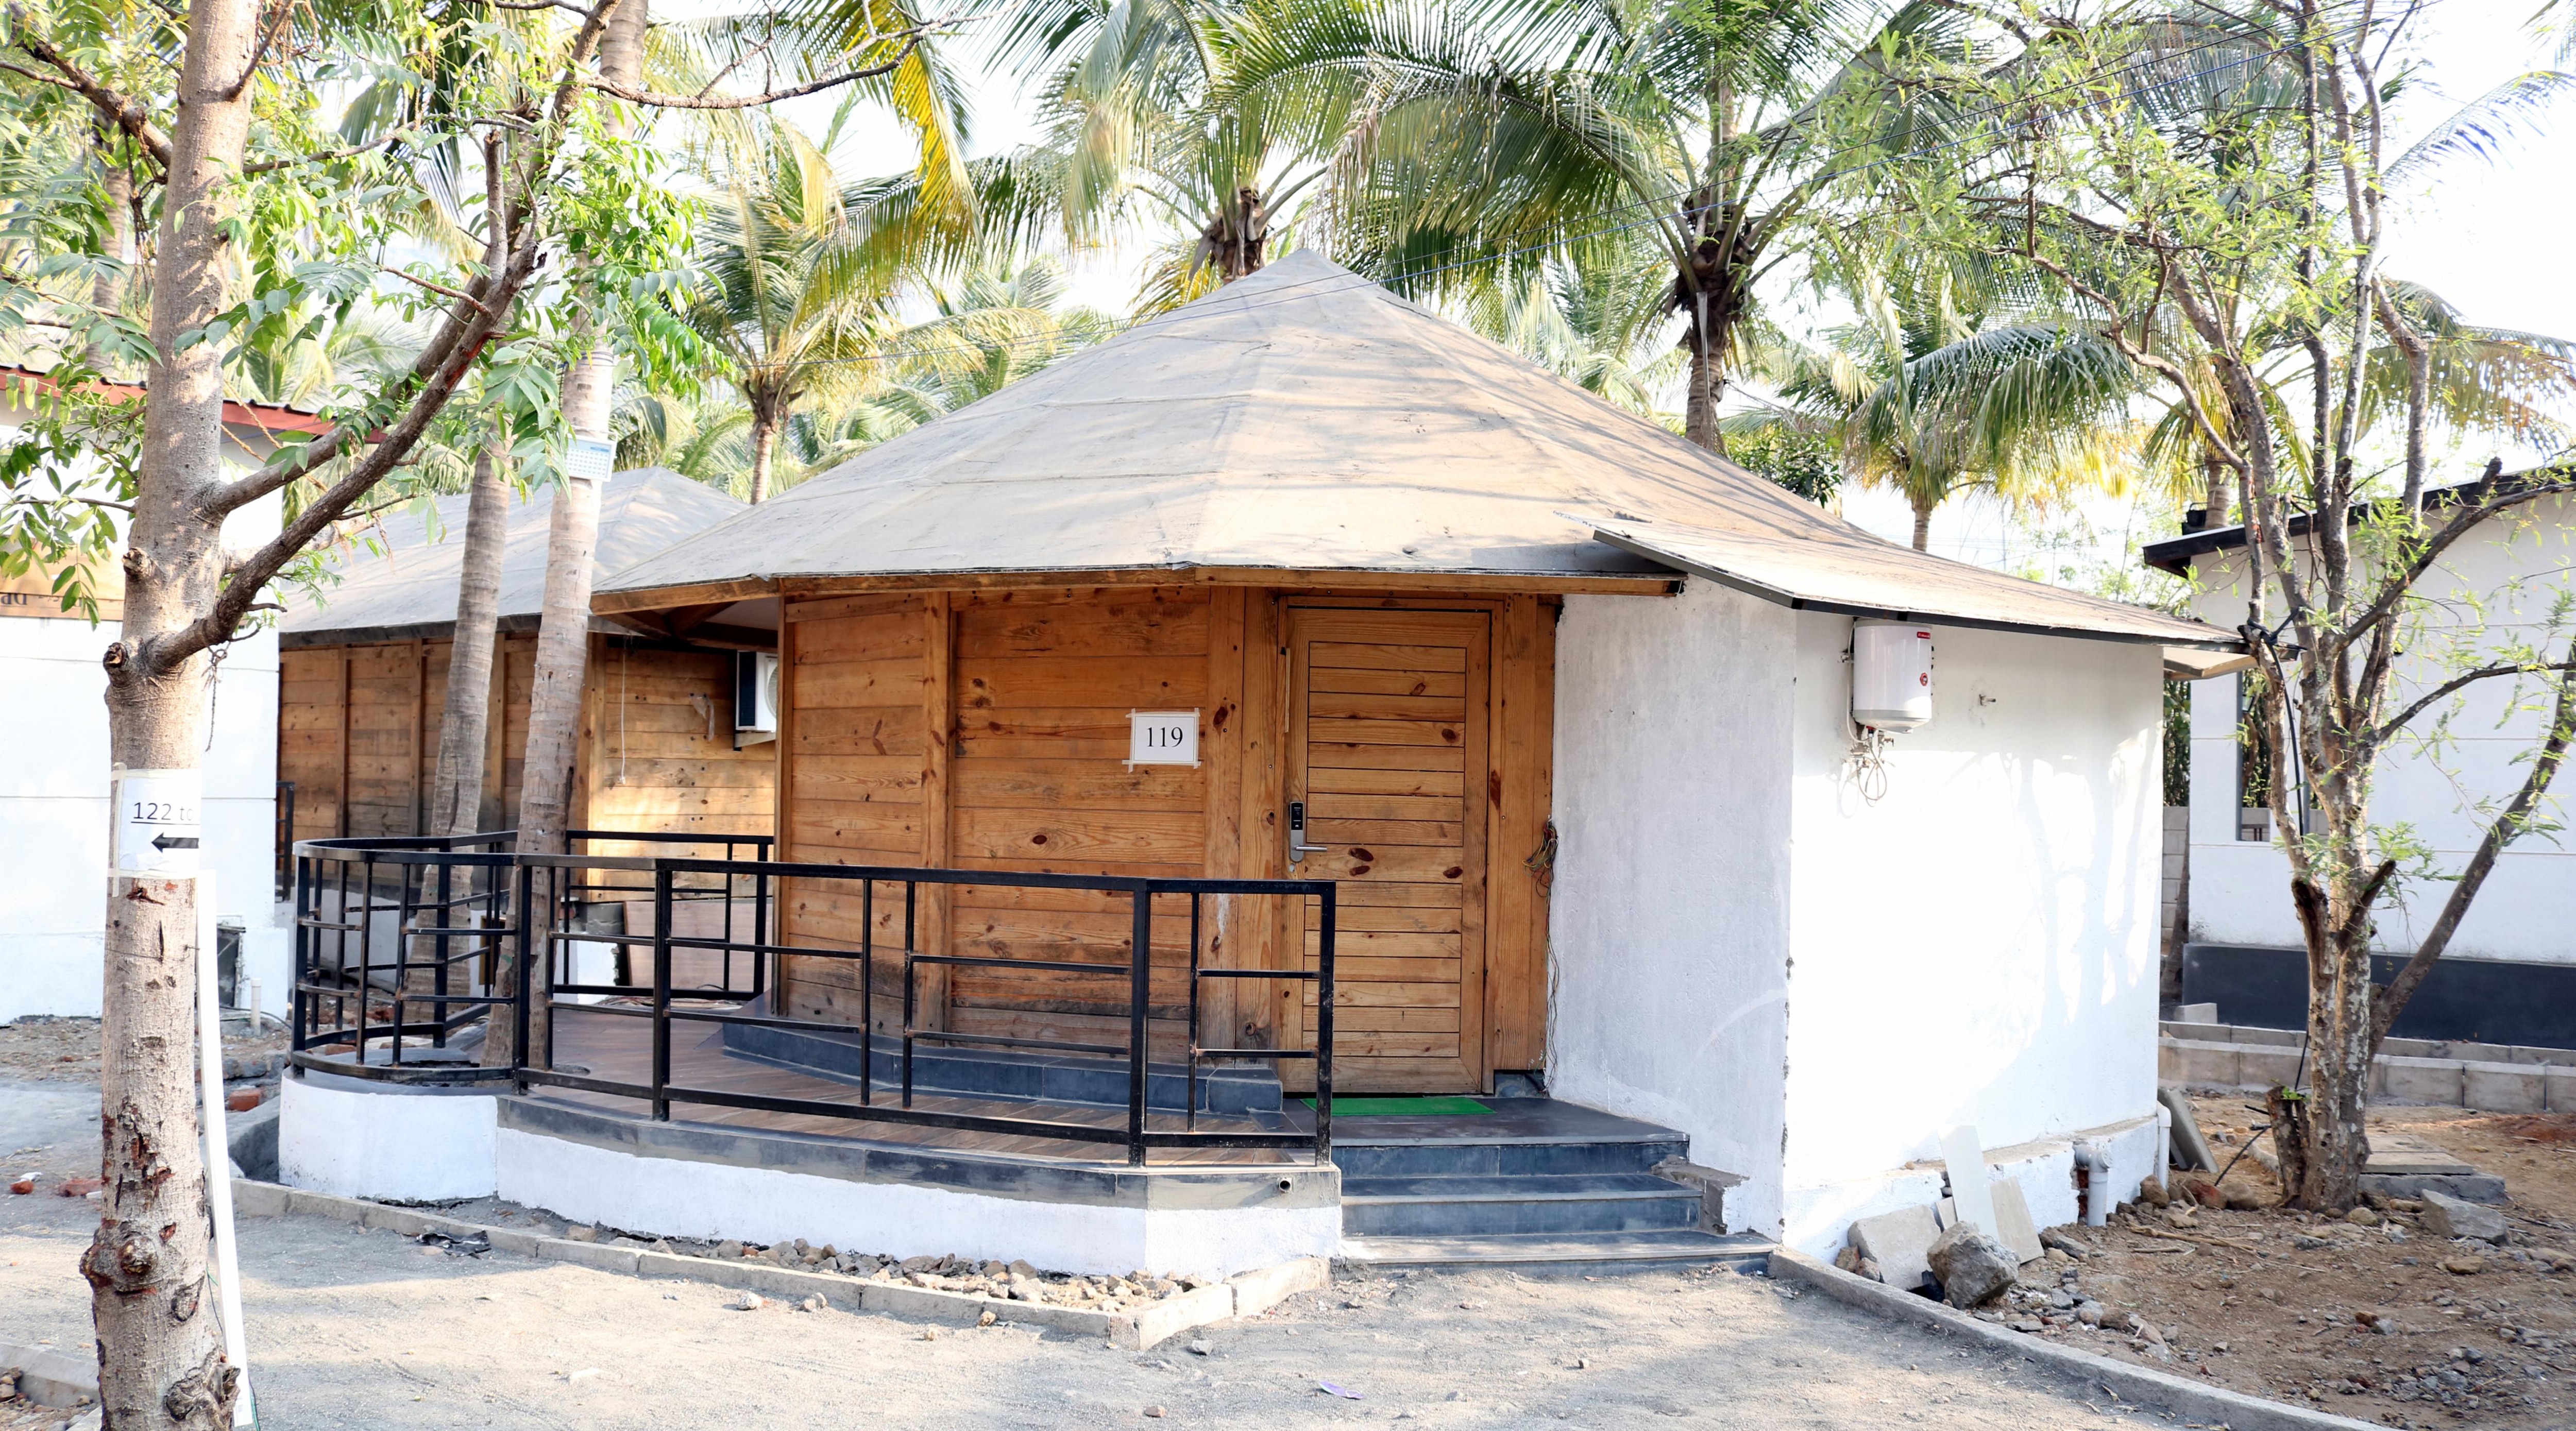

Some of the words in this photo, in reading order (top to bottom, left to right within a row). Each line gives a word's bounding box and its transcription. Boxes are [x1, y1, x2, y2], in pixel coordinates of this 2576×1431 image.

[1147, 726, 1183, 747] 119
[133, 802, 172, 820] 122
[179, 806, 194, 821] to
